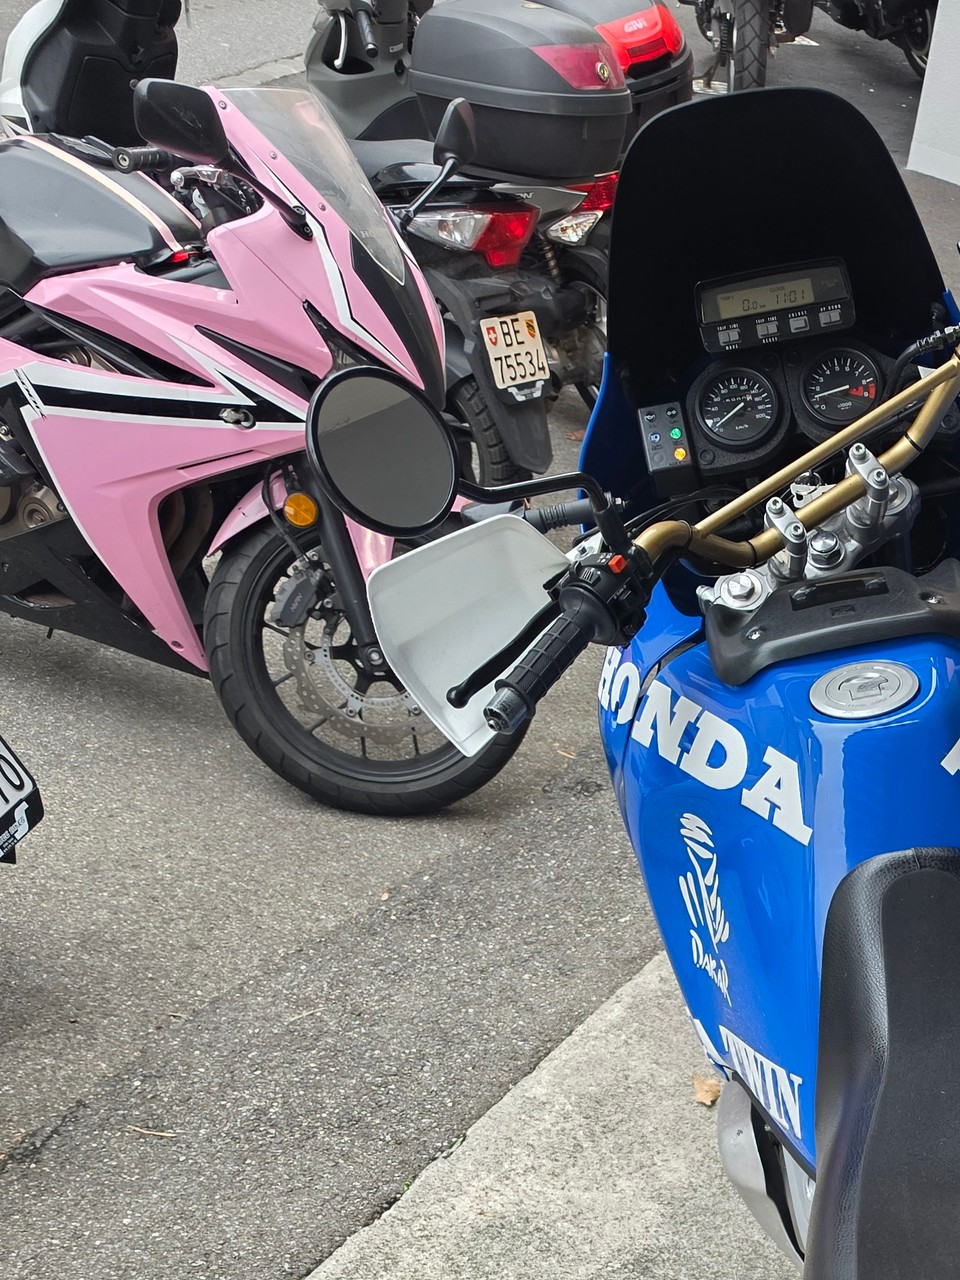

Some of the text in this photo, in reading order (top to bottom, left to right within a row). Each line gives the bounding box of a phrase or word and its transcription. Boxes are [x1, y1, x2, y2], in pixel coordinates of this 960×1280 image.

[742, 299, 758, 312] 0.0
[775, 289, 805, 305] 11:01
[499, 318, 525, 347] BE
[494, 348, 546, 384] 75534
[598, 646, 813, 847] HONDA
[719, 1025, 803, 1140] TWIN
